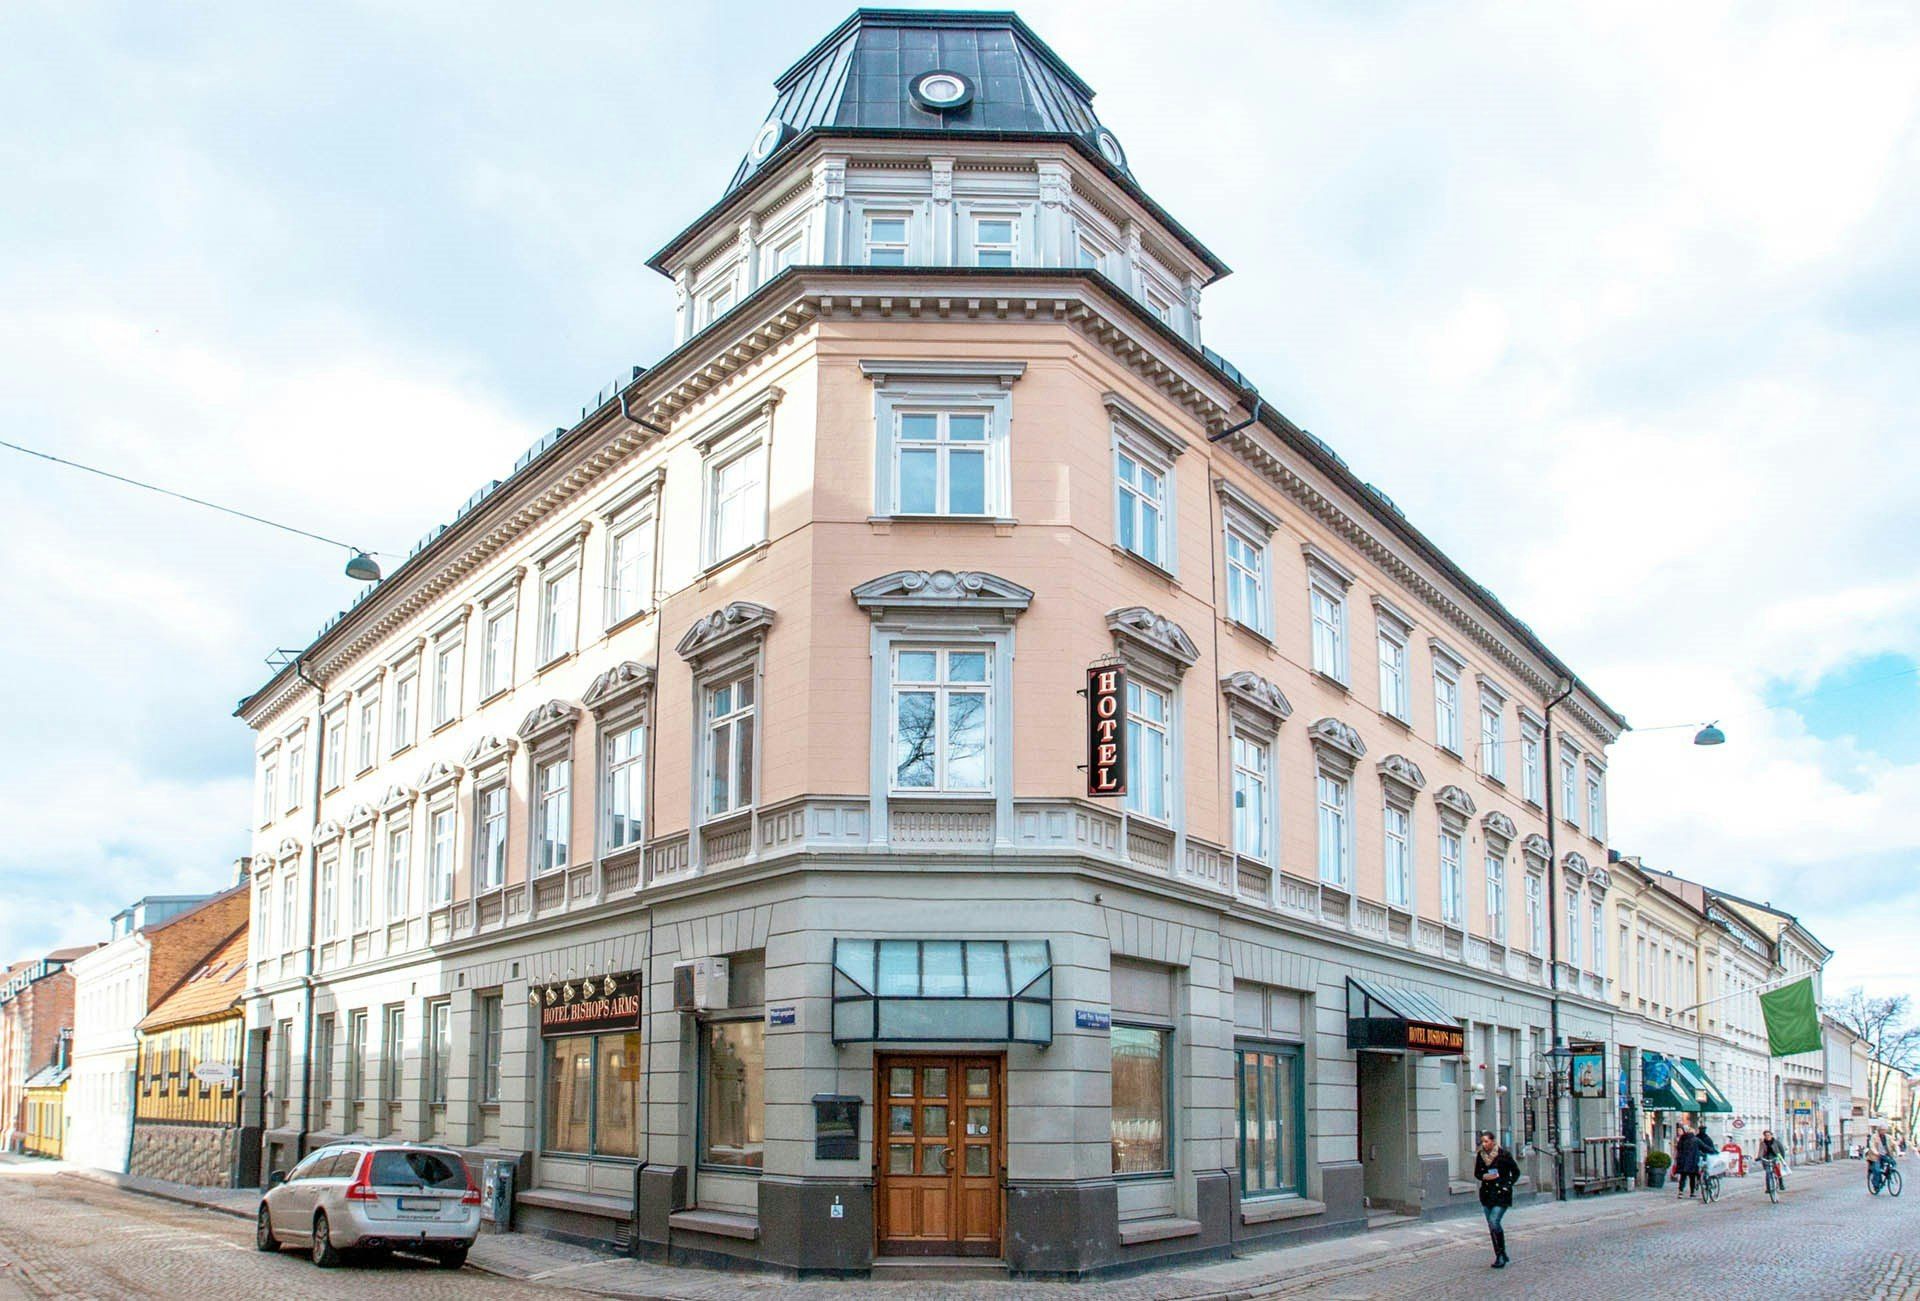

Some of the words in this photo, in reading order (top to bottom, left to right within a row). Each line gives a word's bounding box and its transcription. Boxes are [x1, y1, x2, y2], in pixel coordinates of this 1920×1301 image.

[1097, 670, 1117, 790] HOTEL
[543, 1005, 570, 1024] HOTEL
[571, 999, 610, 1020] BISHOPS
[610, 995, 639, 1017] ARMS
[1408, 1026, 1426, 1043] HOTEL
[1427, 1028, 1449, 1047] BISHOPS
[1449, 1032, 1463, 1049] ARMS
